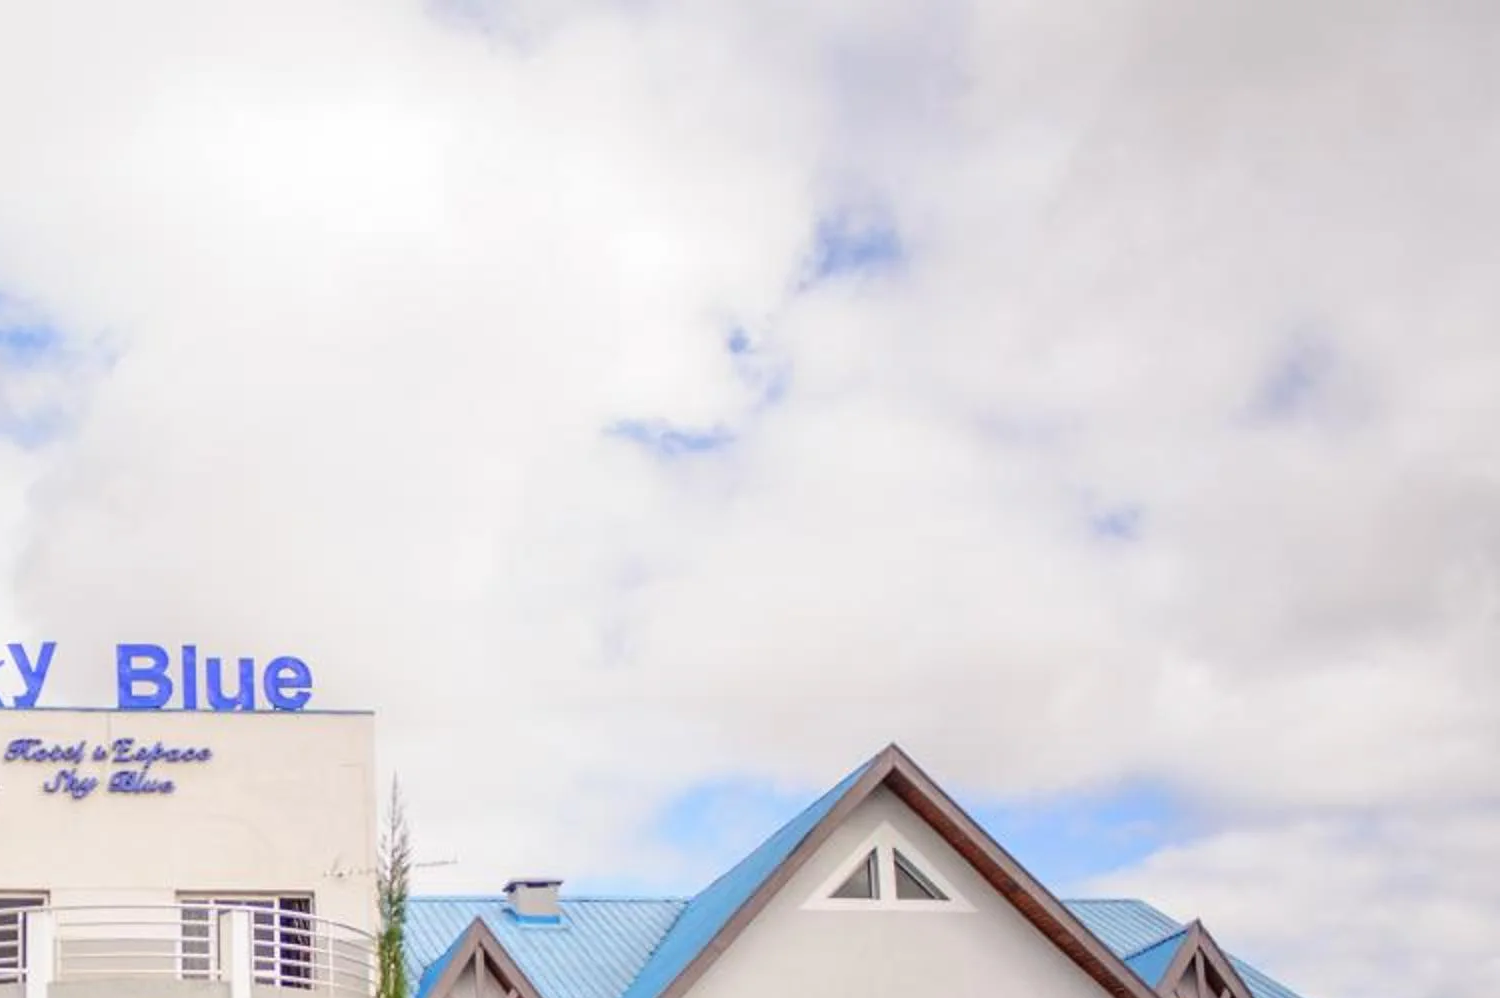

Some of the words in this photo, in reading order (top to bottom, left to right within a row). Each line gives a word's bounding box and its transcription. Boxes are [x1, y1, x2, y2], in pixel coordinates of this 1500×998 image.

[116, 643, 314, 711] Blue
[112, 738, 212, 770] Espace
[43, 767, 99, 800] Sky
[108, 766, 175, 793] Blue
